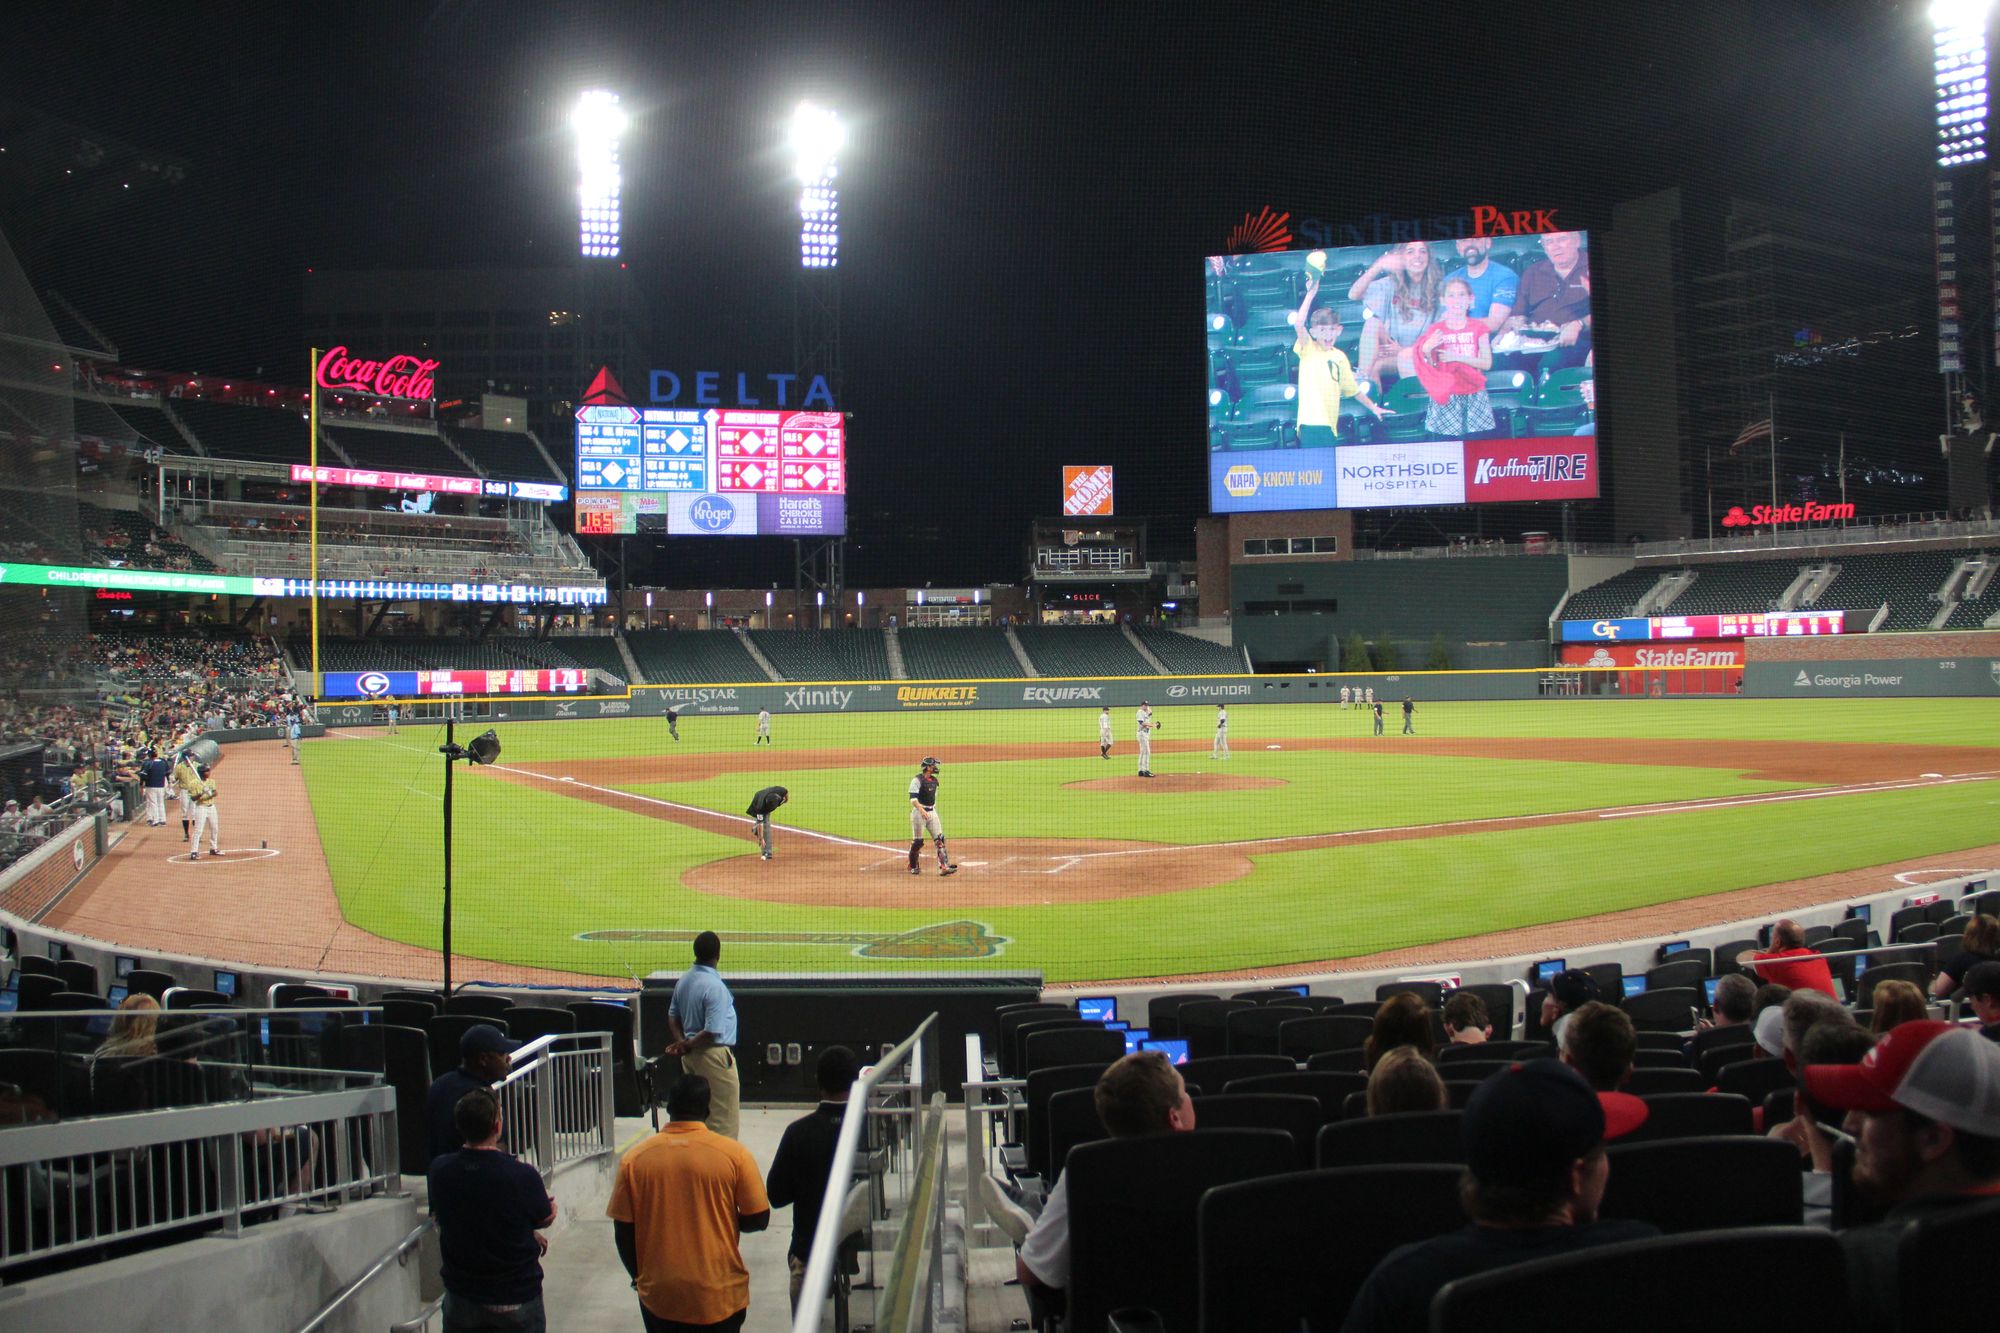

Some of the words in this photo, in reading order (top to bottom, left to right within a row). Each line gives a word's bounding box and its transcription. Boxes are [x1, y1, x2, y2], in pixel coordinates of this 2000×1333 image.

[1472, 205, 1560, 237] PARK
[316, 345, 440, 400] Coca-Cola
[651, 369, 834, 406] DELTA
[144, 450, 160, 464] 42
[1343, 462, 1458, 479] NORTHSIDE
[1474, 458, 1546, 484] Kauffman
[1530, 454, 1587, 481] TIRE
[1230, 473, 1256, 489] NAPA
[1263, 471, 1294, 487] KNOW
[1298, 470, 1322, 486] HOW
[1364, 479, 1437, 490] HOSPITAL
[1064, 466, 1111, 514] HOME
[586, 512, 612, 526] 165
[694, 500, 732, 528] Kroger
[48, 570, 108, 584] CHILDREN'S
[458, 588, 462, 596] R
[488, 589, 492, 597] H
[517, 590, 521, 598] E
[545, 589, 556, 600] 78
[1723, 616, 1736, 624] AVG
[1815, 675, 1861, 688] Georgia
[1864, 674, 1902, 685] Power
[659, 689, 736, 702] WELLSTAR
[784, 686, 853, 709] xfinity
[897, 686, 977, 701] QUIKRETE
[1023, 687, 1103, 703] EQUIFAX
[1192, 685, 1250, 696] HYUNDAI
[719, 705, 739, 713] System
